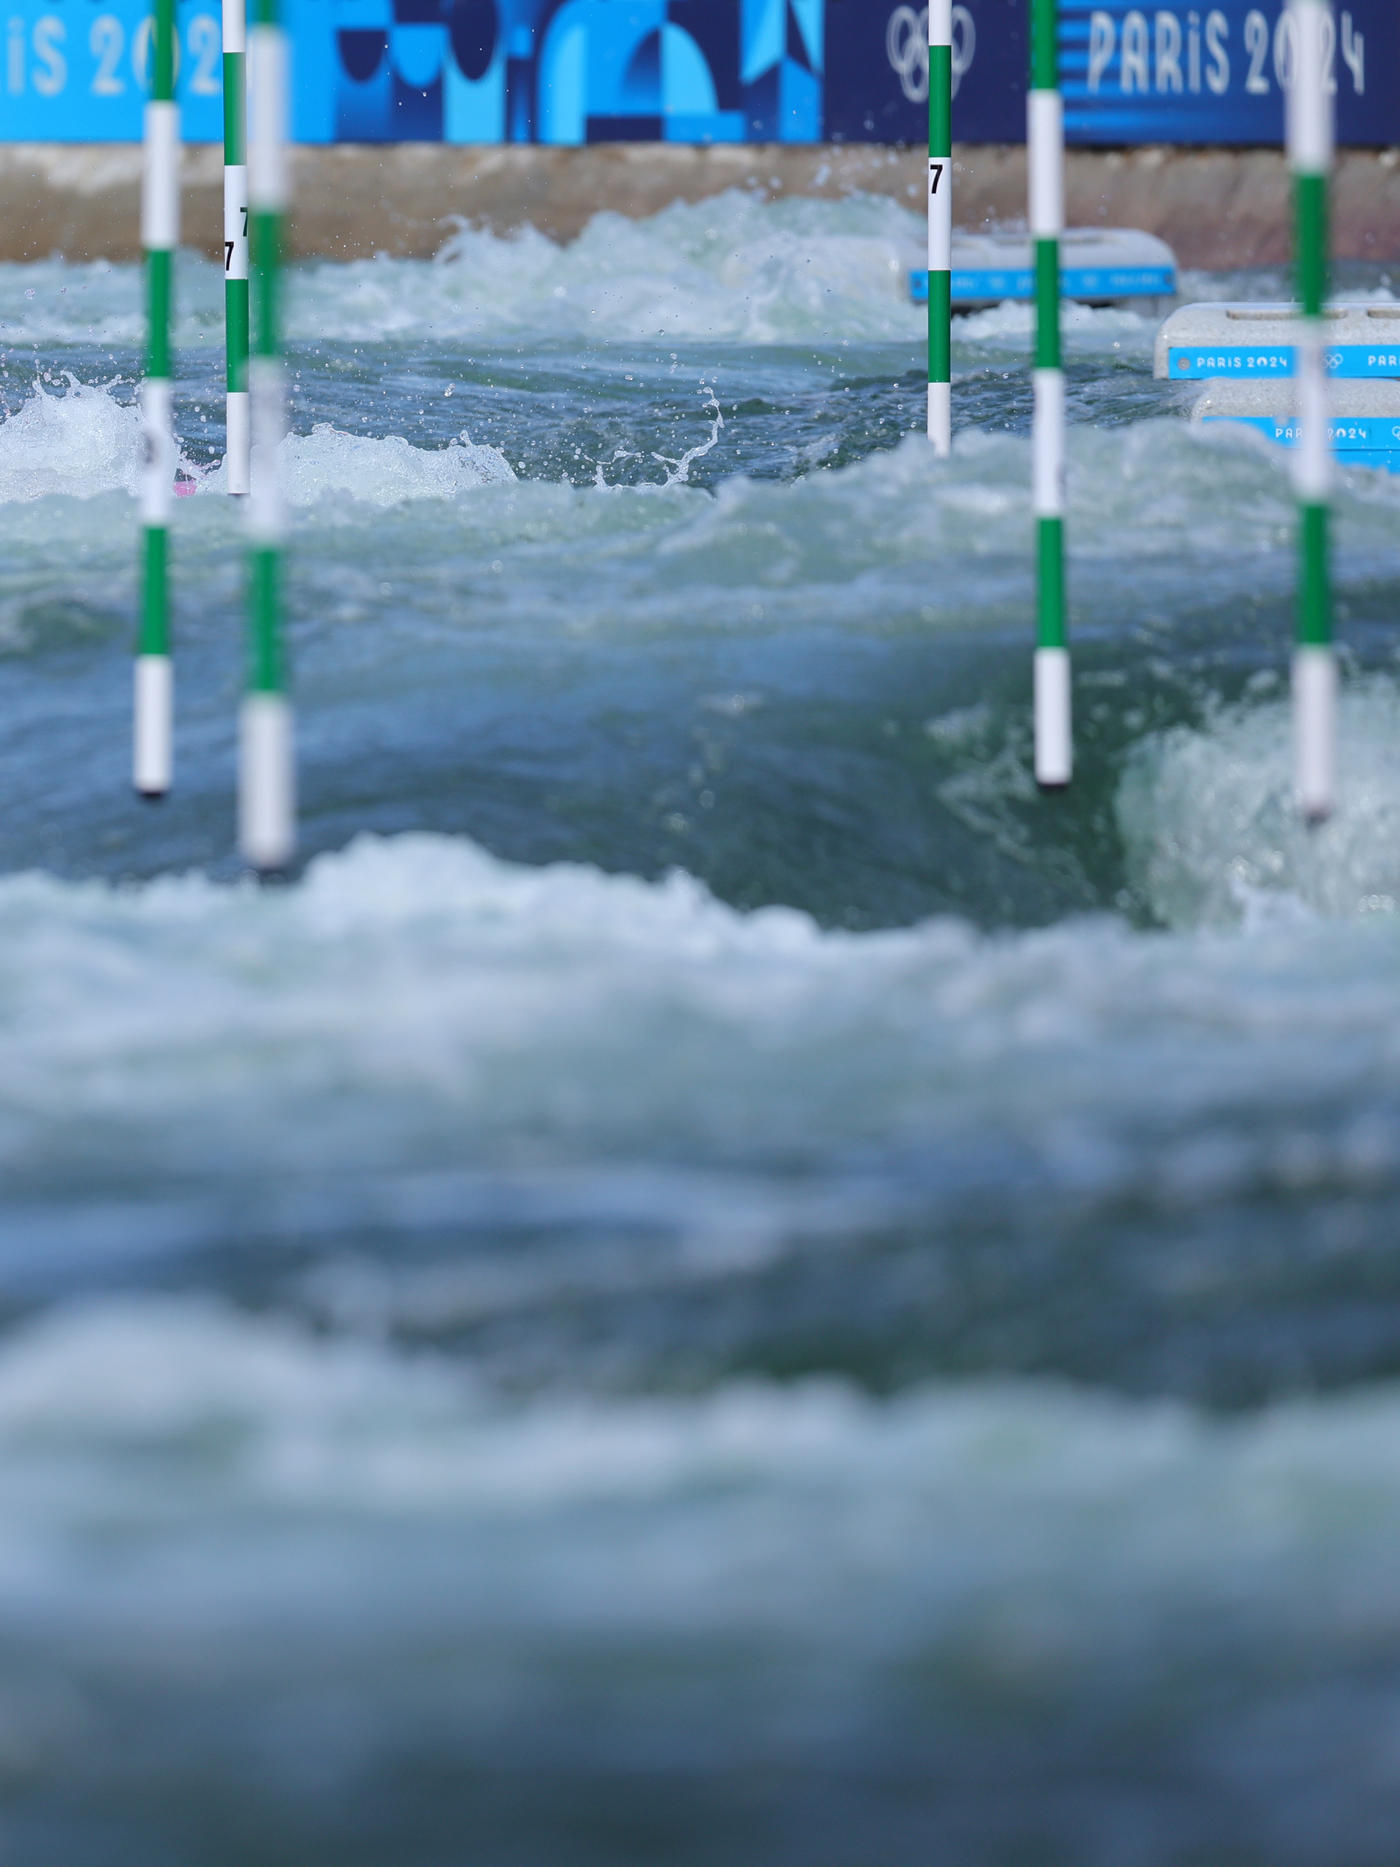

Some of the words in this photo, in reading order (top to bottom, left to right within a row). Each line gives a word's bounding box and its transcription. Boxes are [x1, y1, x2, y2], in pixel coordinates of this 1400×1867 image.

[89, 15, 224, 96] 202
[930, 164, 943, 194] 7
[240, 206, 248, 237] 7
[225, 241, 234, 271] 7
[1247, 357, 1288, 368] 2024
[1367, 355, 1400, 366] PAR
[1275, 428, 1304, 438] PAR
